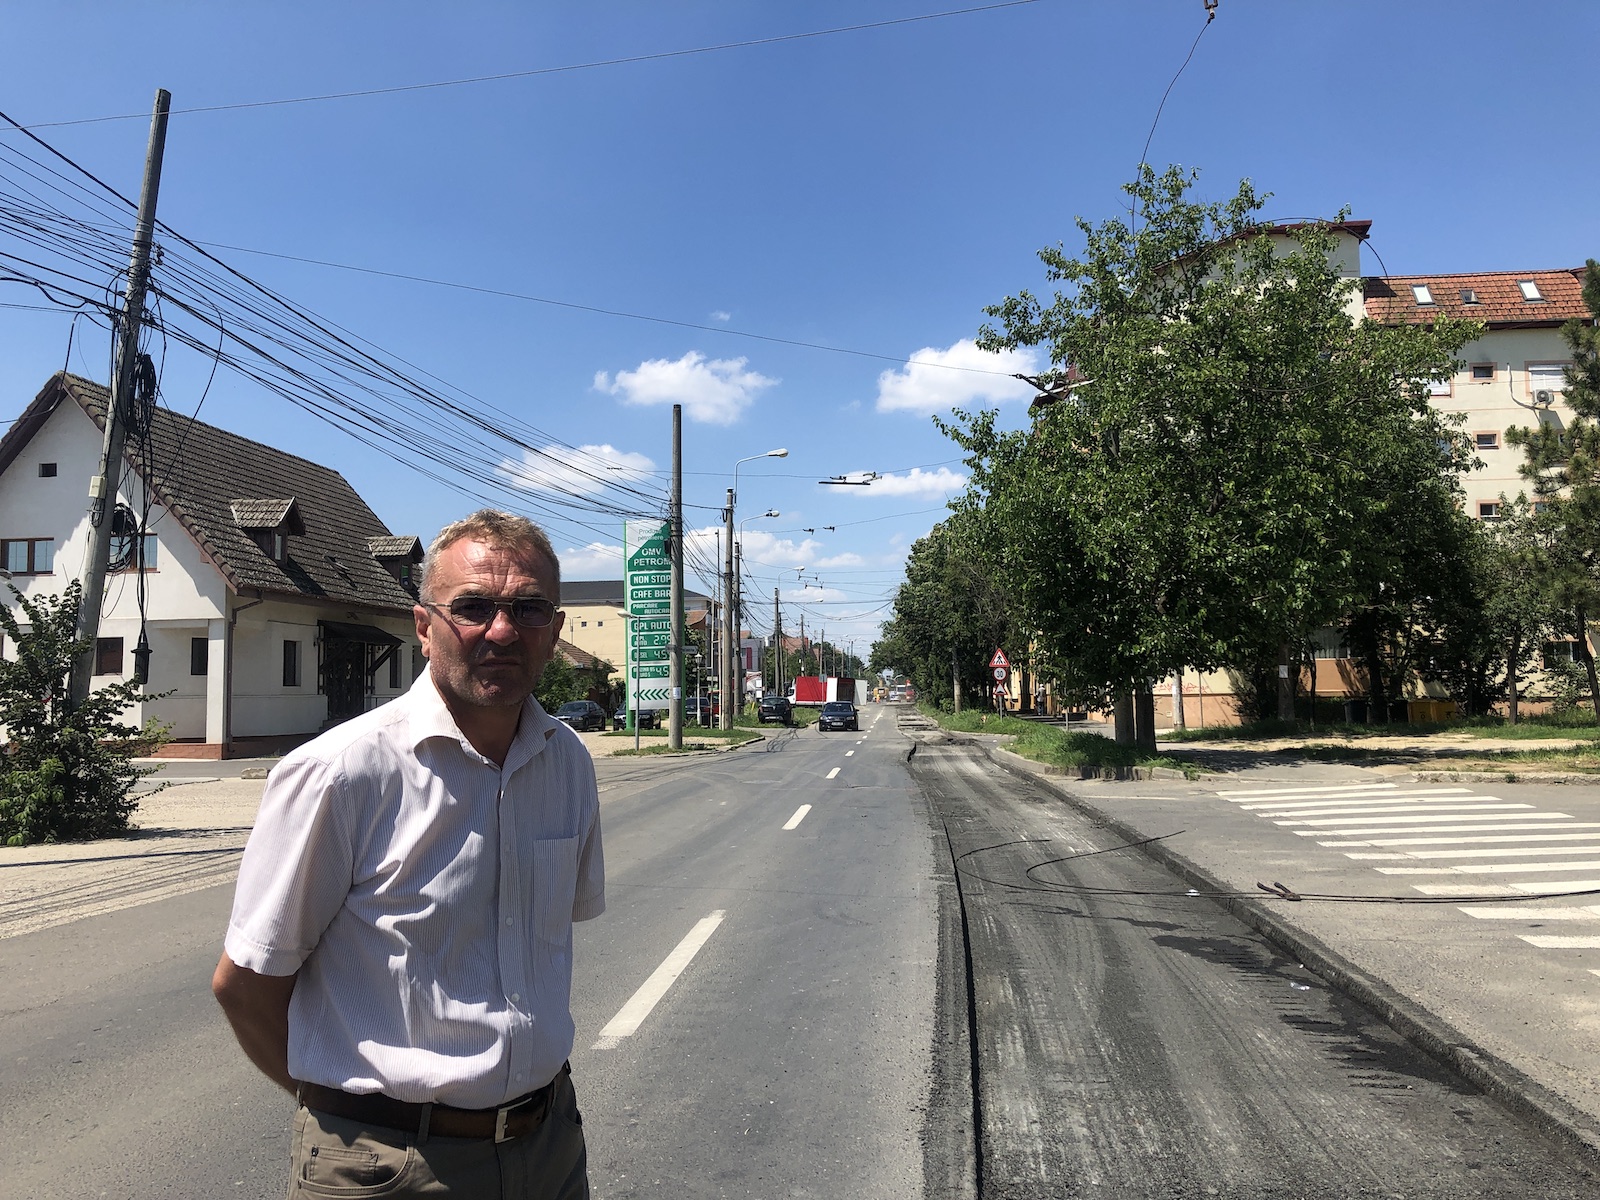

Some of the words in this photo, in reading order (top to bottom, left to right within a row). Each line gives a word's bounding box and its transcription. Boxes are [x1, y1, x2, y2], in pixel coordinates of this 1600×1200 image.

[641, 548, 661, 556] OMV
[634, 576, 649, 584] NON
[651, 575, 671, 583] STOP
[634, 590, 652, 598] CAFE
[655, 590, 671, 598] BAR
[997, 670, 1004, 678] 30
